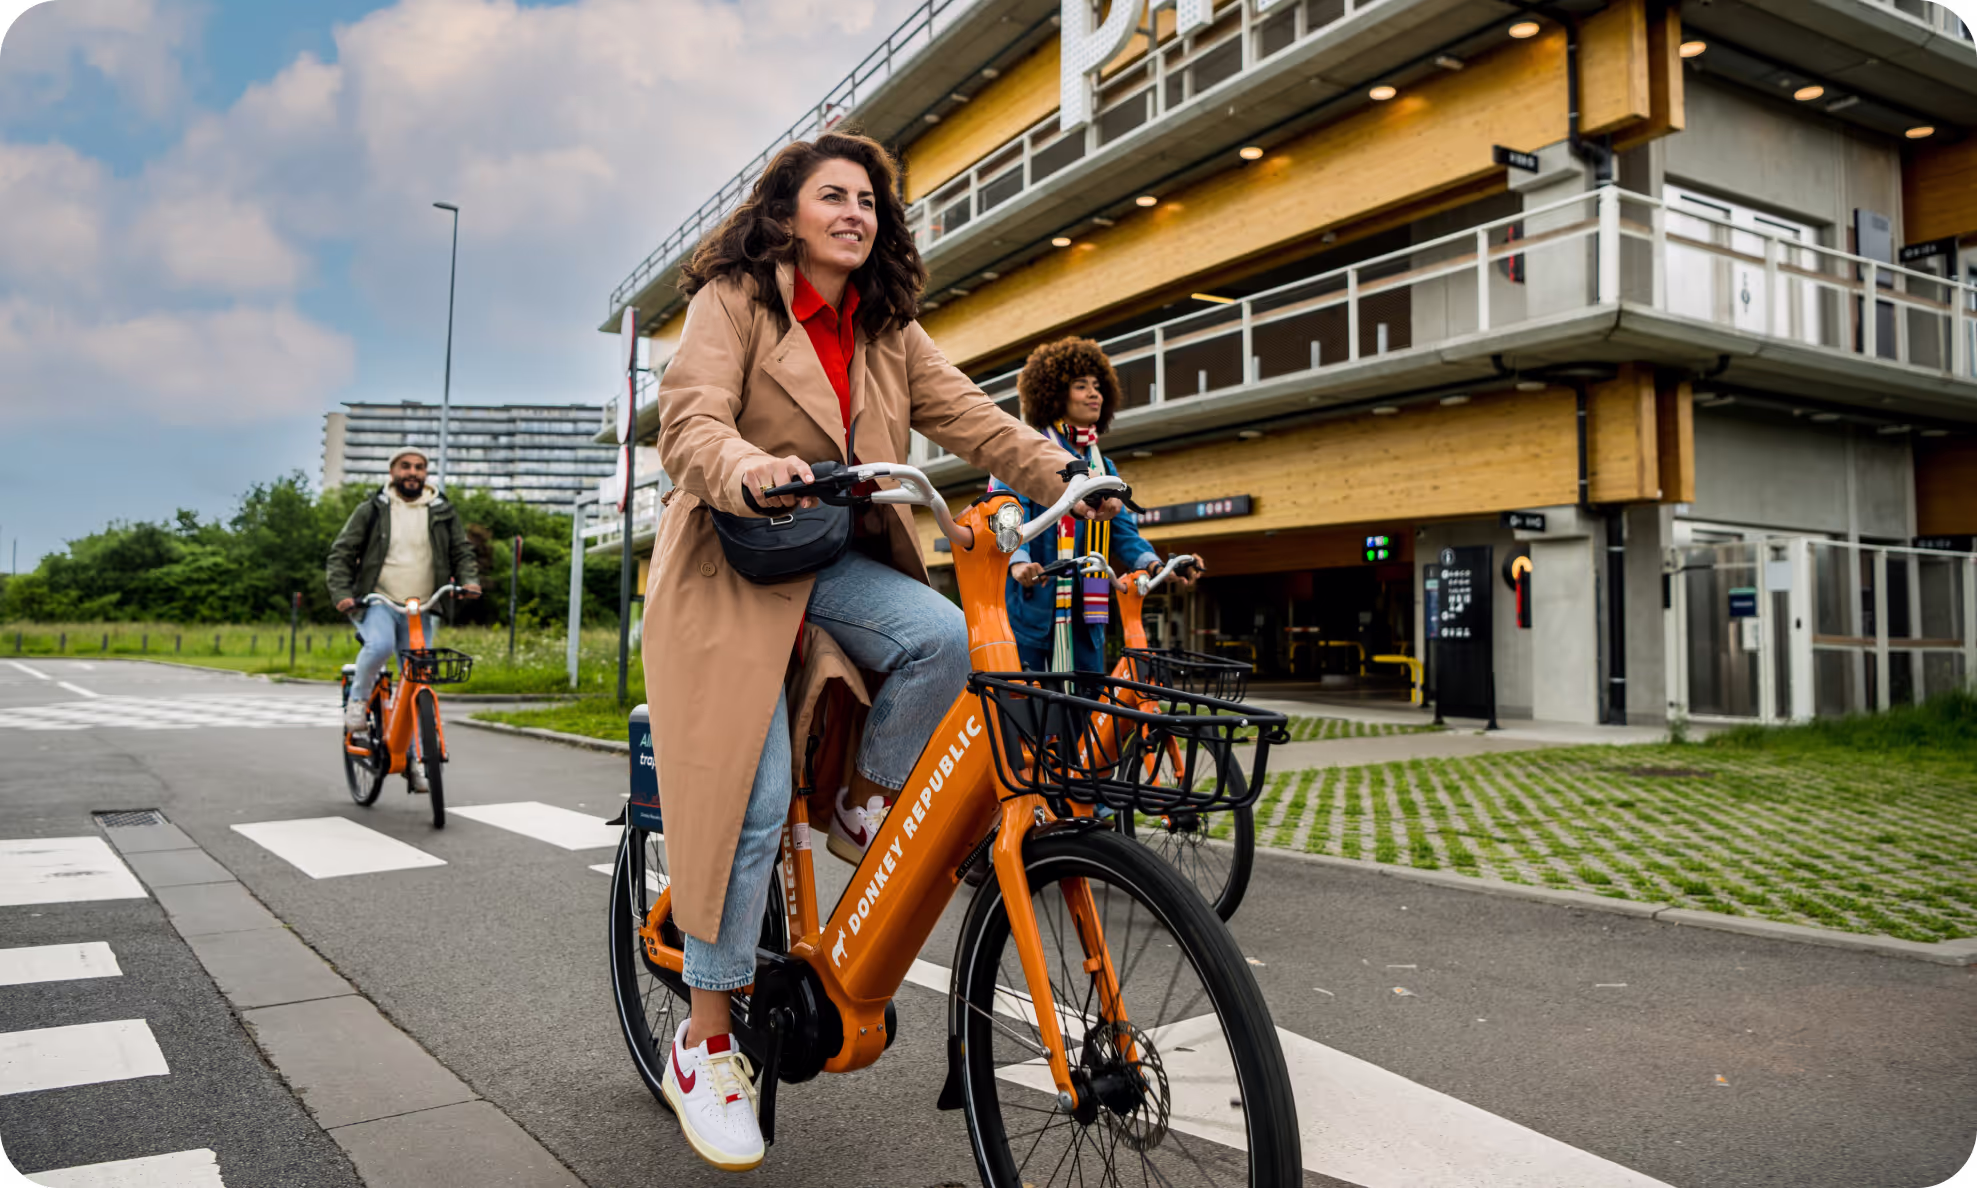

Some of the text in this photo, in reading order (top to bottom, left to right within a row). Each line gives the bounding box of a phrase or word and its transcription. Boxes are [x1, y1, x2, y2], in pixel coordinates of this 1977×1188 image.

[782, 818, 798, 916] ELECTRI
[848, 715, 982, 936] DONKEY REPUBLIC
